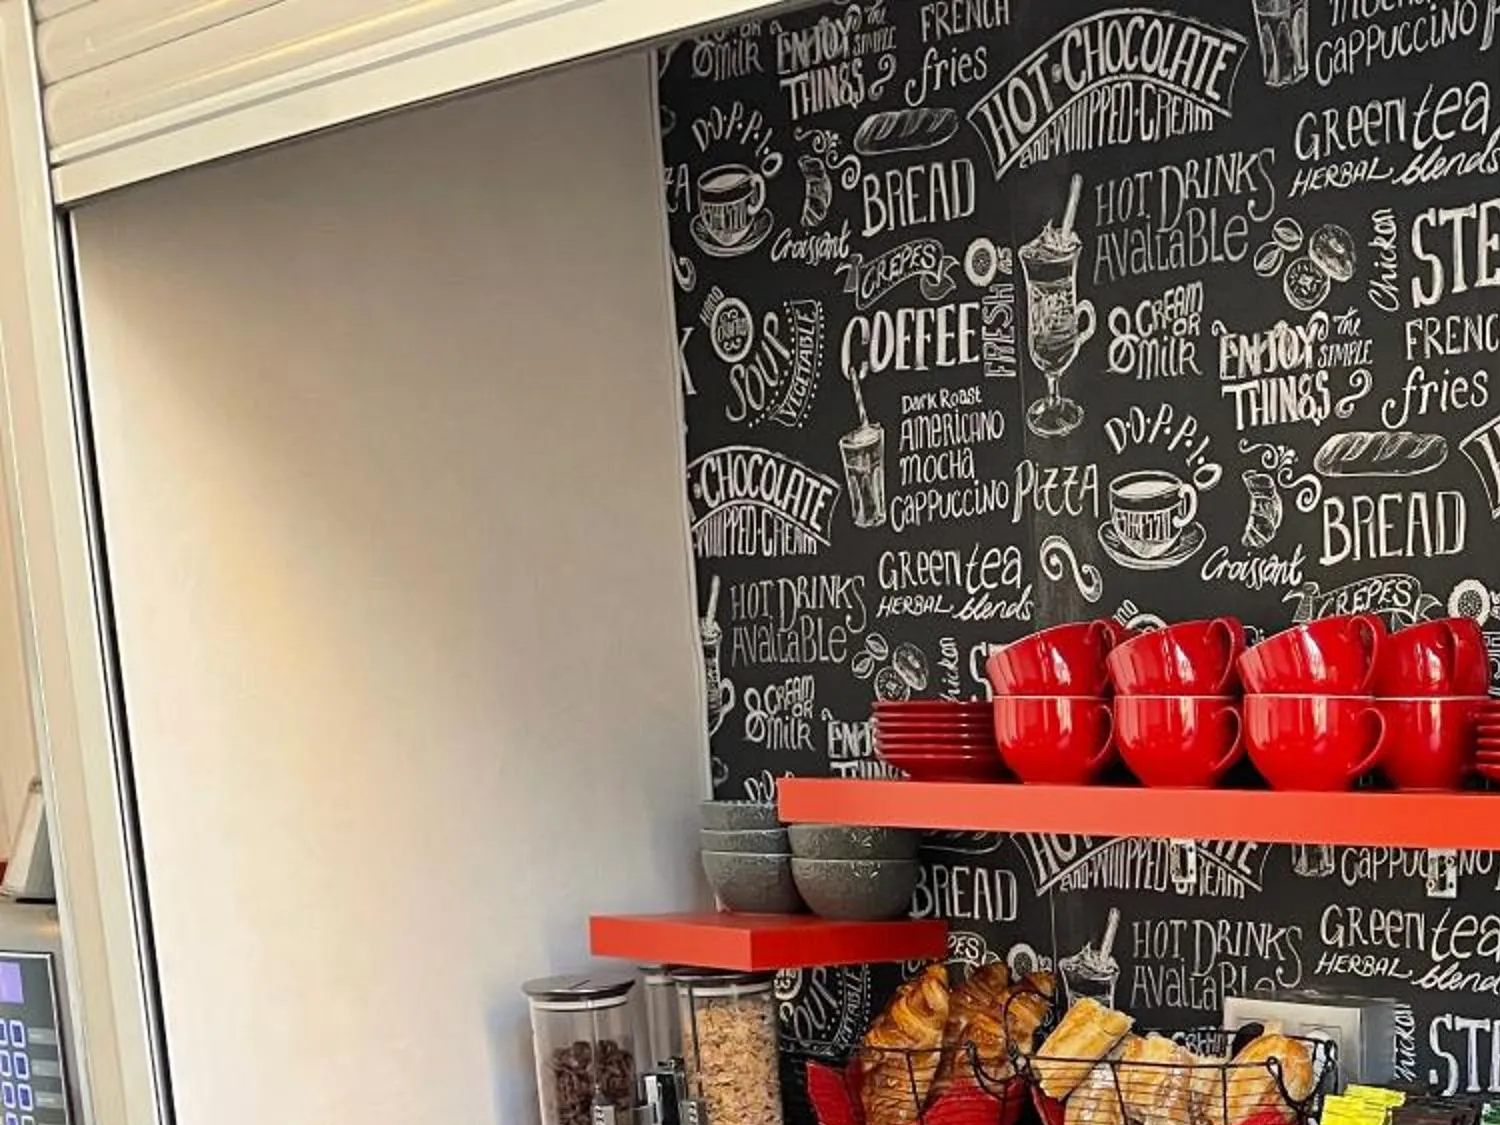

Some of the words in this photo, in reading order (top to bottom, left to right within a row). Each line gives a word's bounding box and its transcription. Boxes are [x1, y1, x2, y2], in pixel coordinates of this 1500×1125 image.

[770, 4, 863, 75] ENJOY
[921, 0, 1010, 42] FRENCH
[780, 58, 866, 121] THINGS
[904, 46, 988, 107] fries
[980, 52, 1053, 165] HOT
[1061, 16, 1238, 101] CHOCOLATE
[1412, 81, 1490, 151] tea
[862, 158, 976, 237] BREAD
[1095, 171, 1153, 227] HOT
[1158, 148, 1275, 233] DRINKS
[1288, 157, 1394, 198] HERBAL
[771, 218, 850, 266] Croissant
[861, 242, 937, 300] CREPES
[841, 302, 981, 380] COFFEE
[1172, 313, 1201, 336] OR
[1212, 310, 1330, 380] ENJOY
[1334, 306, 1361, 337] the
[1317, 339, 1373, 369] SIMPLE
[726, 311, 791, 421] SOUP
[1222, 373, 1331, 431] THINGS
[1381, 365, 1489, 429] fries
[701, 454, 833, 532] CHOCOLATE
[1319, 491, 1467, 566] BREAD
[965, 543, 1022, 595] tea
[1200, 544, 1306, 590] Croissant
[730, 578, 773, 621] HOT
[777, 574, 867, 634] DRINKS
[876, 595, 954, 620] HERBAL
[953, 583, 1036, 621] blends
[791, 703, 814, 721] OR
[909, 864, 1018, 924] BREAD
[1133, 922, 1187, 961] HOT
[1190, 919, 1302, 988] DRINKS
[1314, 953, 1413, 980] HERBAL
